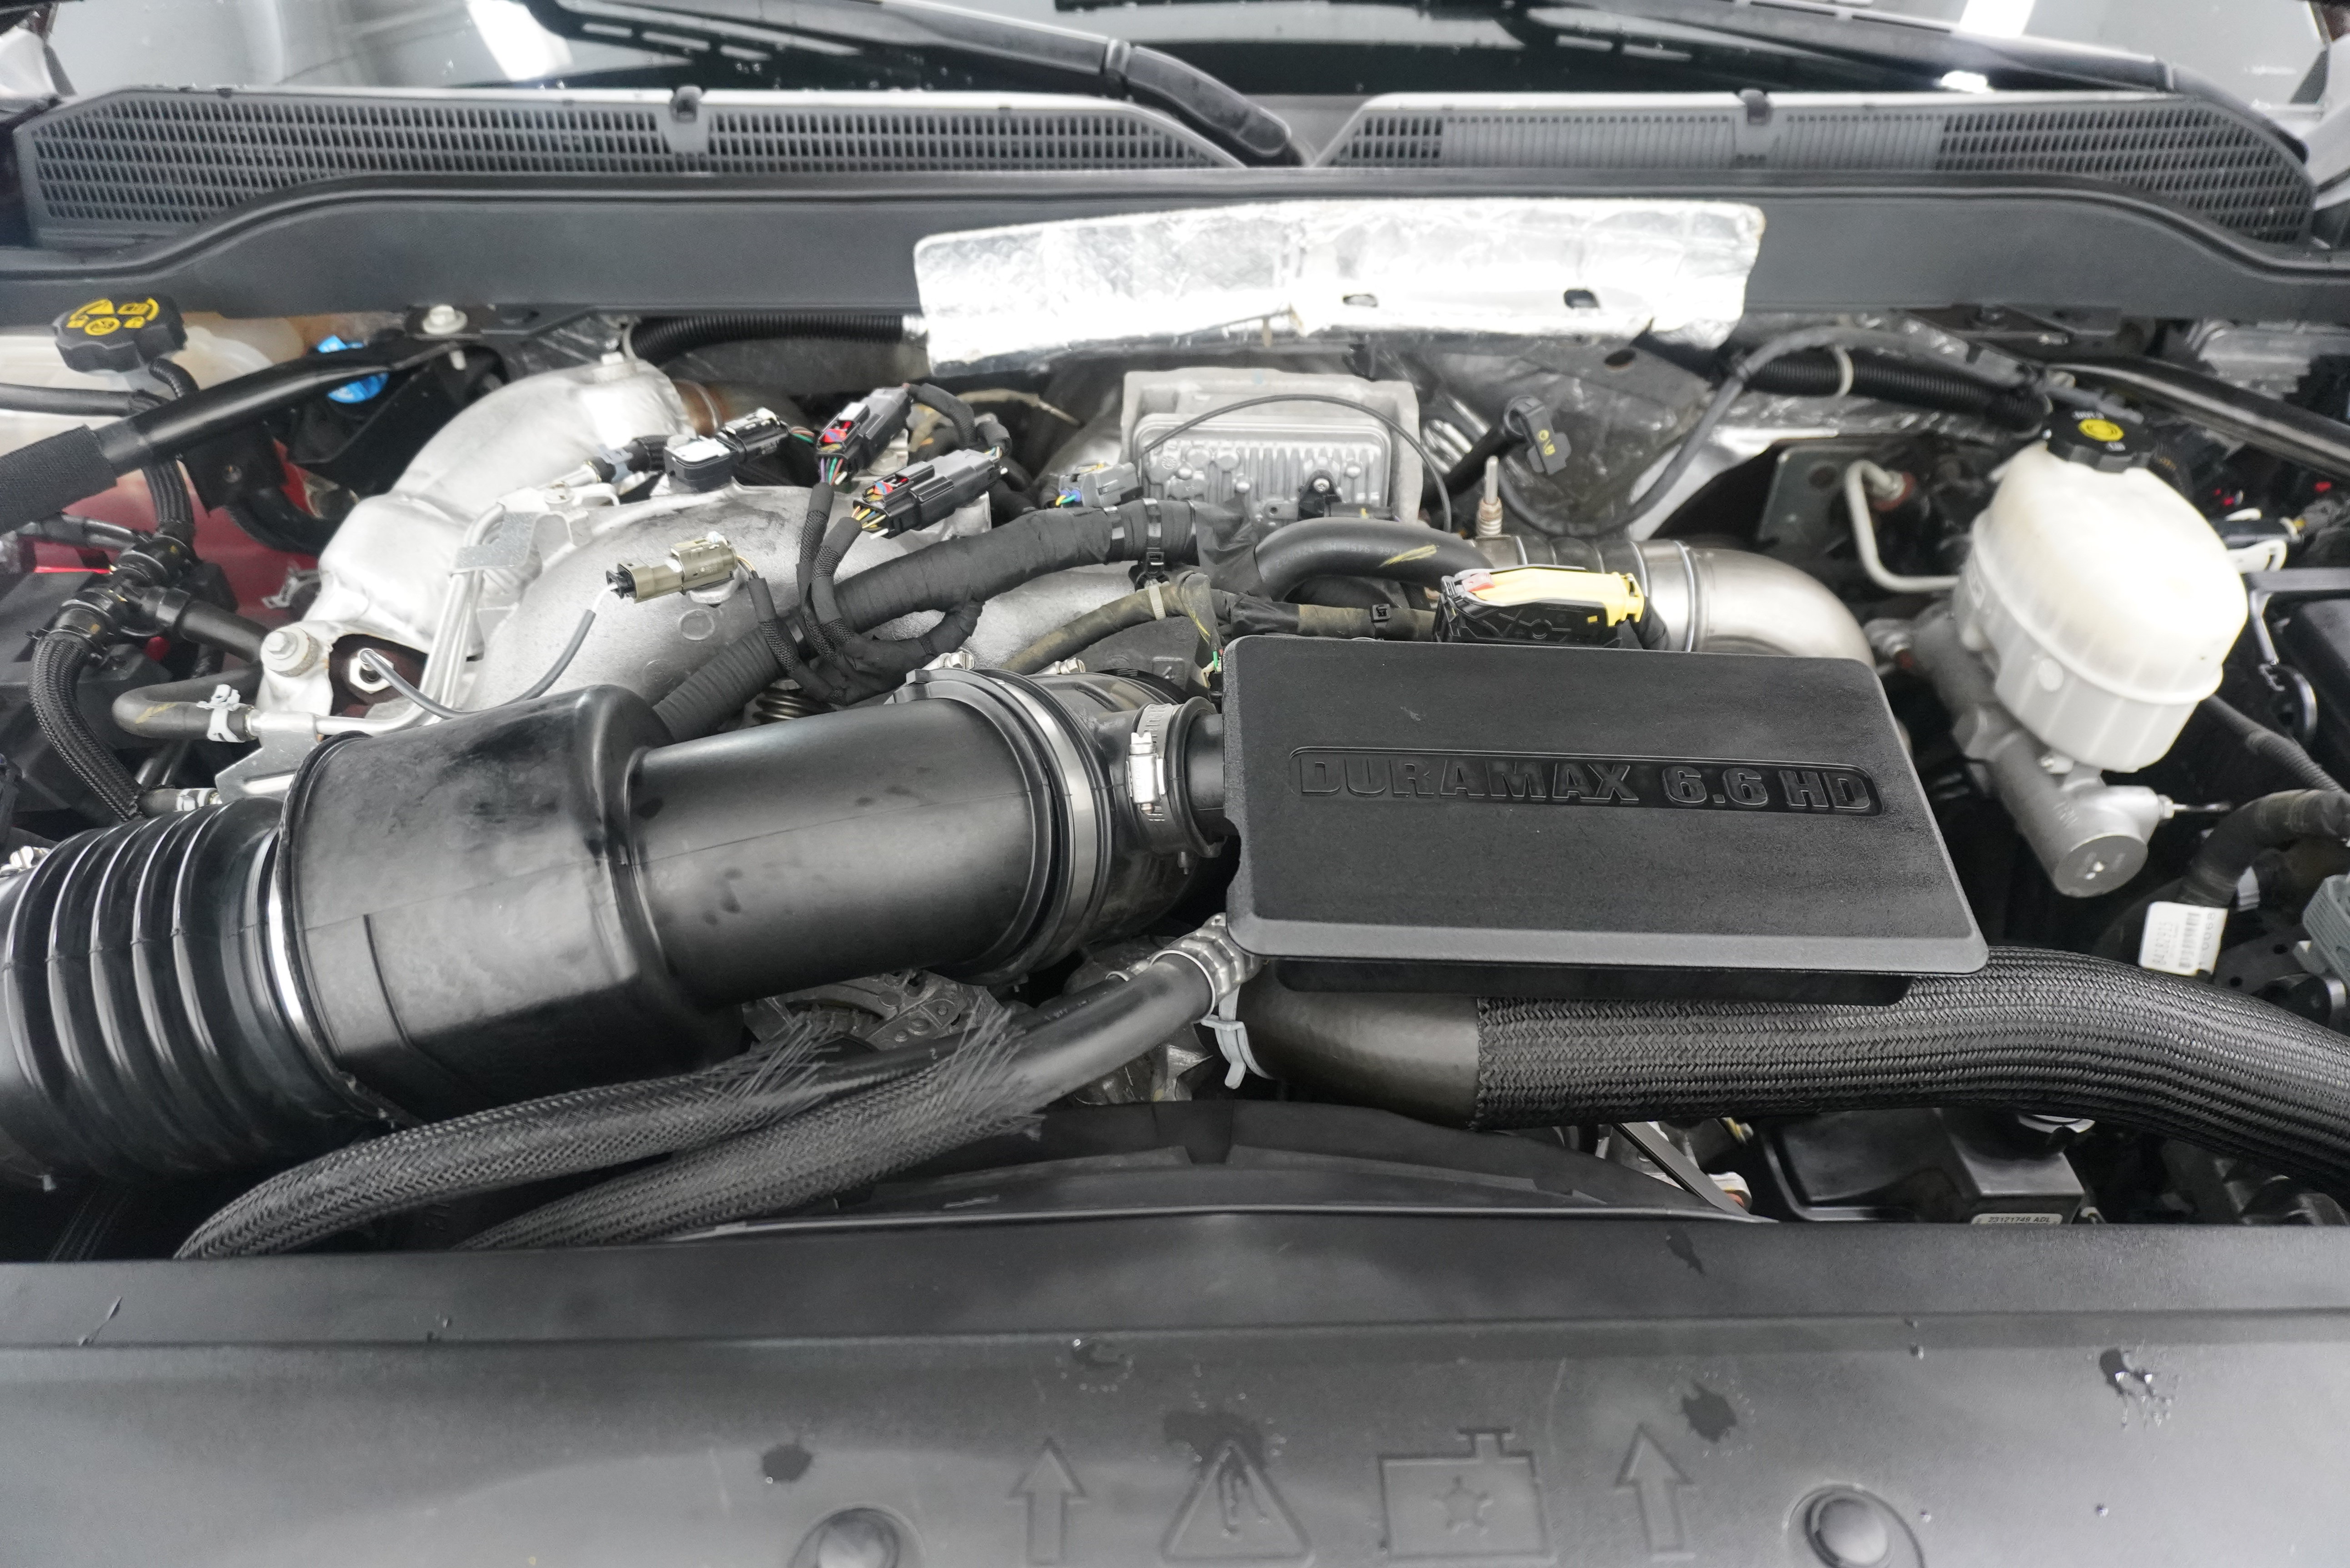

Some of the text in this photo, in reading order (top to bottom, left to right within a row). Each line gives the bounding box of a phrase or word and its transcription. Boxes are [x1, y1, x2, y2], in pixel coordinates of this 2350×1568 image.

[1299, 757, 1871, 810] DURAMAX 6.6 HD
